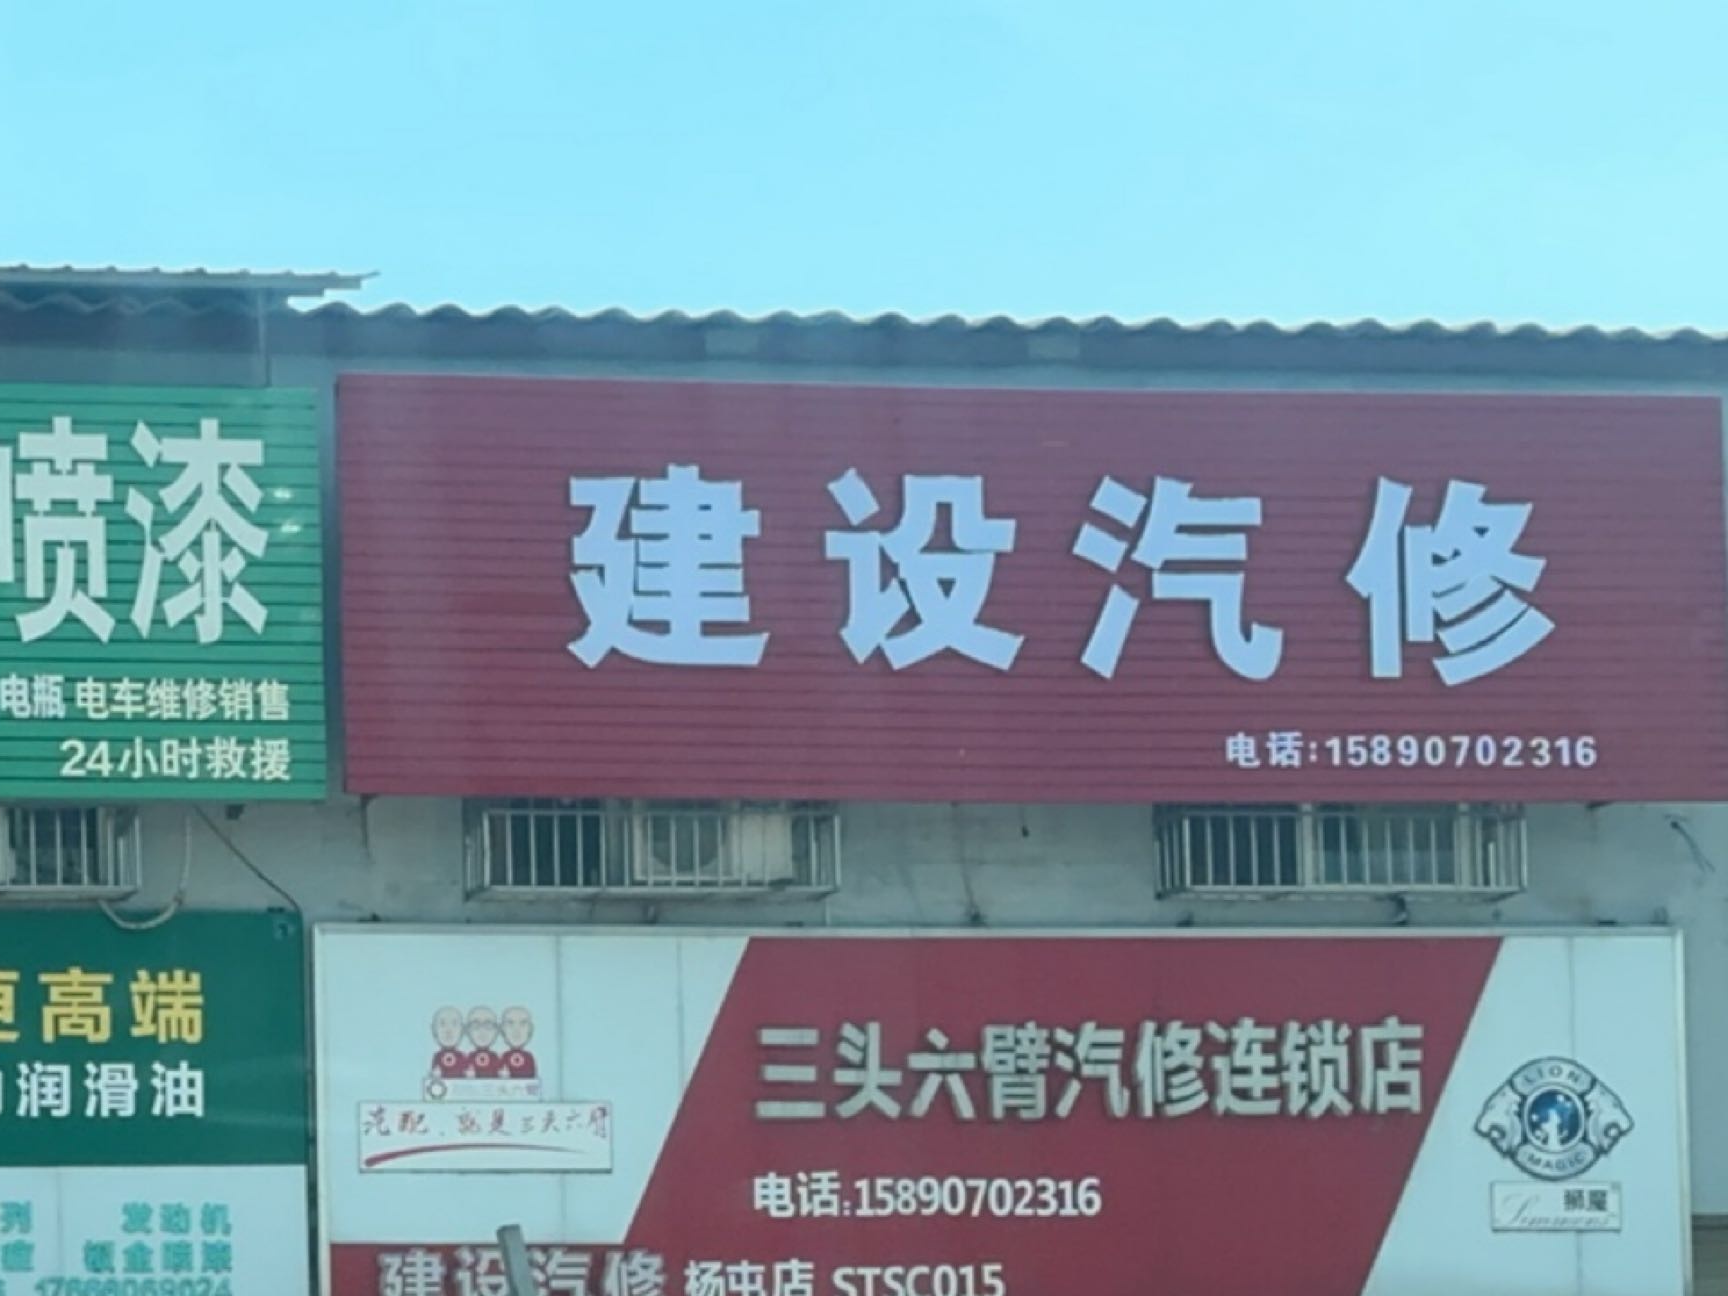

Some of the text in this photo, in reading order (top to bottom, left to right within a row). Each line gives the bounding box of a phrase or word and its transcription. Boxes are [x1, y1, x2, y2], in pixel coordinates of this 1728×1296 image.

[565, 464, 1557, 687] 建设汽修
[0, 673, 66, 718] 电瓶
[76, 677, 289, 720] 电车维修销售
[60, 736, 290, 780] 24小时救援
[757, 1017, 1422, 1118] 三头六臂汽修连锁店
